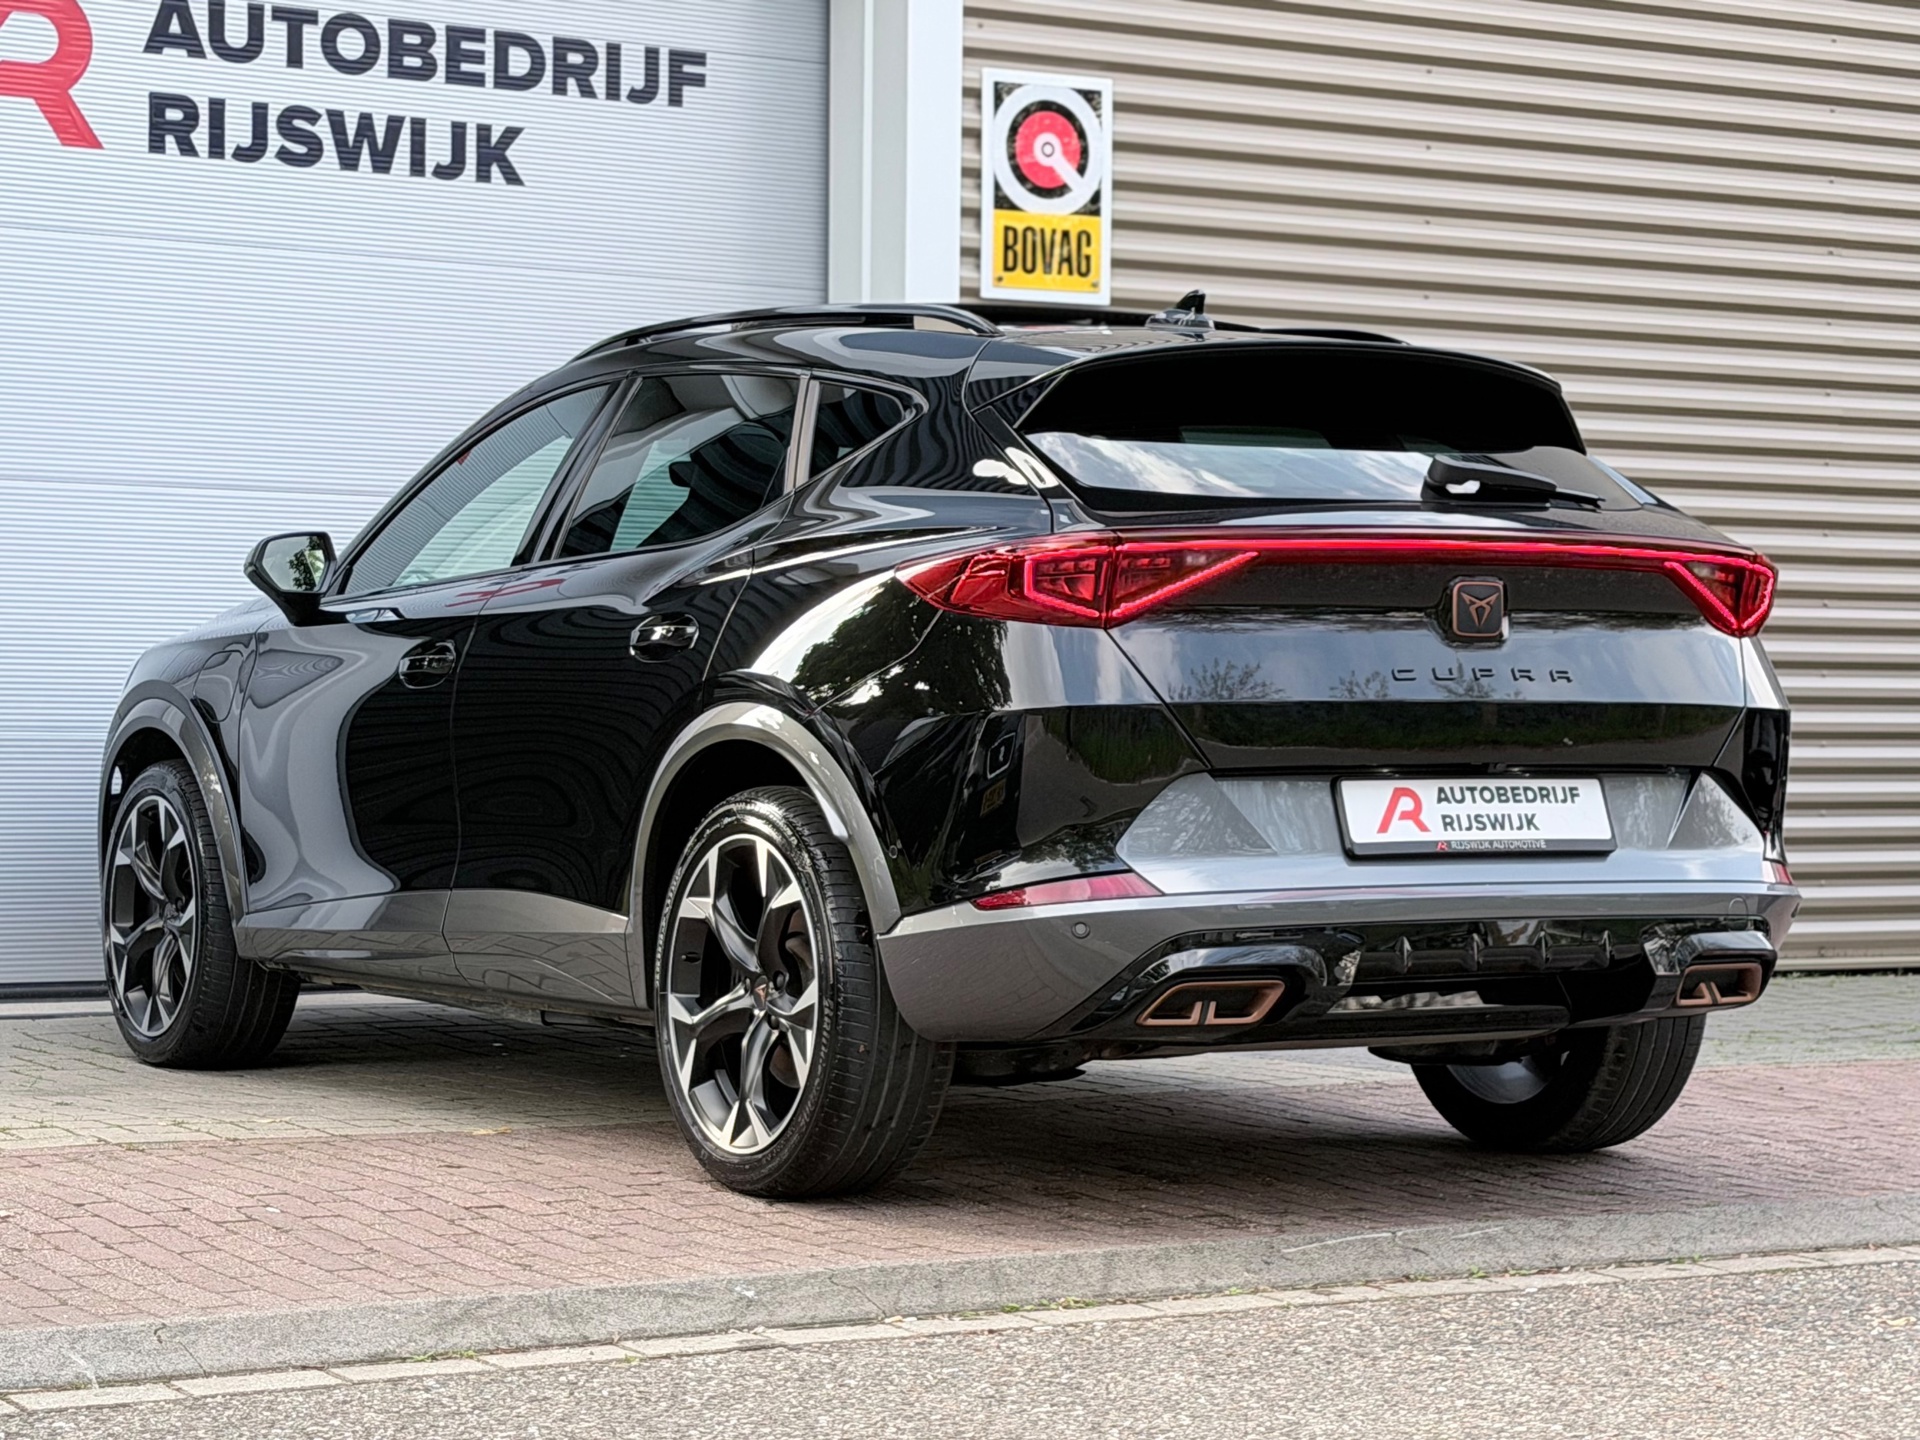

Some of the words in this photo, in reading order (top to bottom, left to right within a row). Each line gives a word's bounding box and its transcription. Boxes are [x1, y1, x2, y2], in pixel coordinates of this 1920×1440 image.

[142, 0, 707, 108] AUTOBEDRIJF
[148, 91, 526, 187] RIJSWIJK
[1003, 225, 1092, 278] BOVAG
[1391, 667, 1574, 683] CUPRA
[1436, 785, 1581, 805] AUTOBEDRIJF
[1440, 813, 1541, 832] RIJSWIJK
[1451, 840, 1491, 850] RIJSWIJK
[1492, 839, 1547, 849] AUTOMOTIVE
